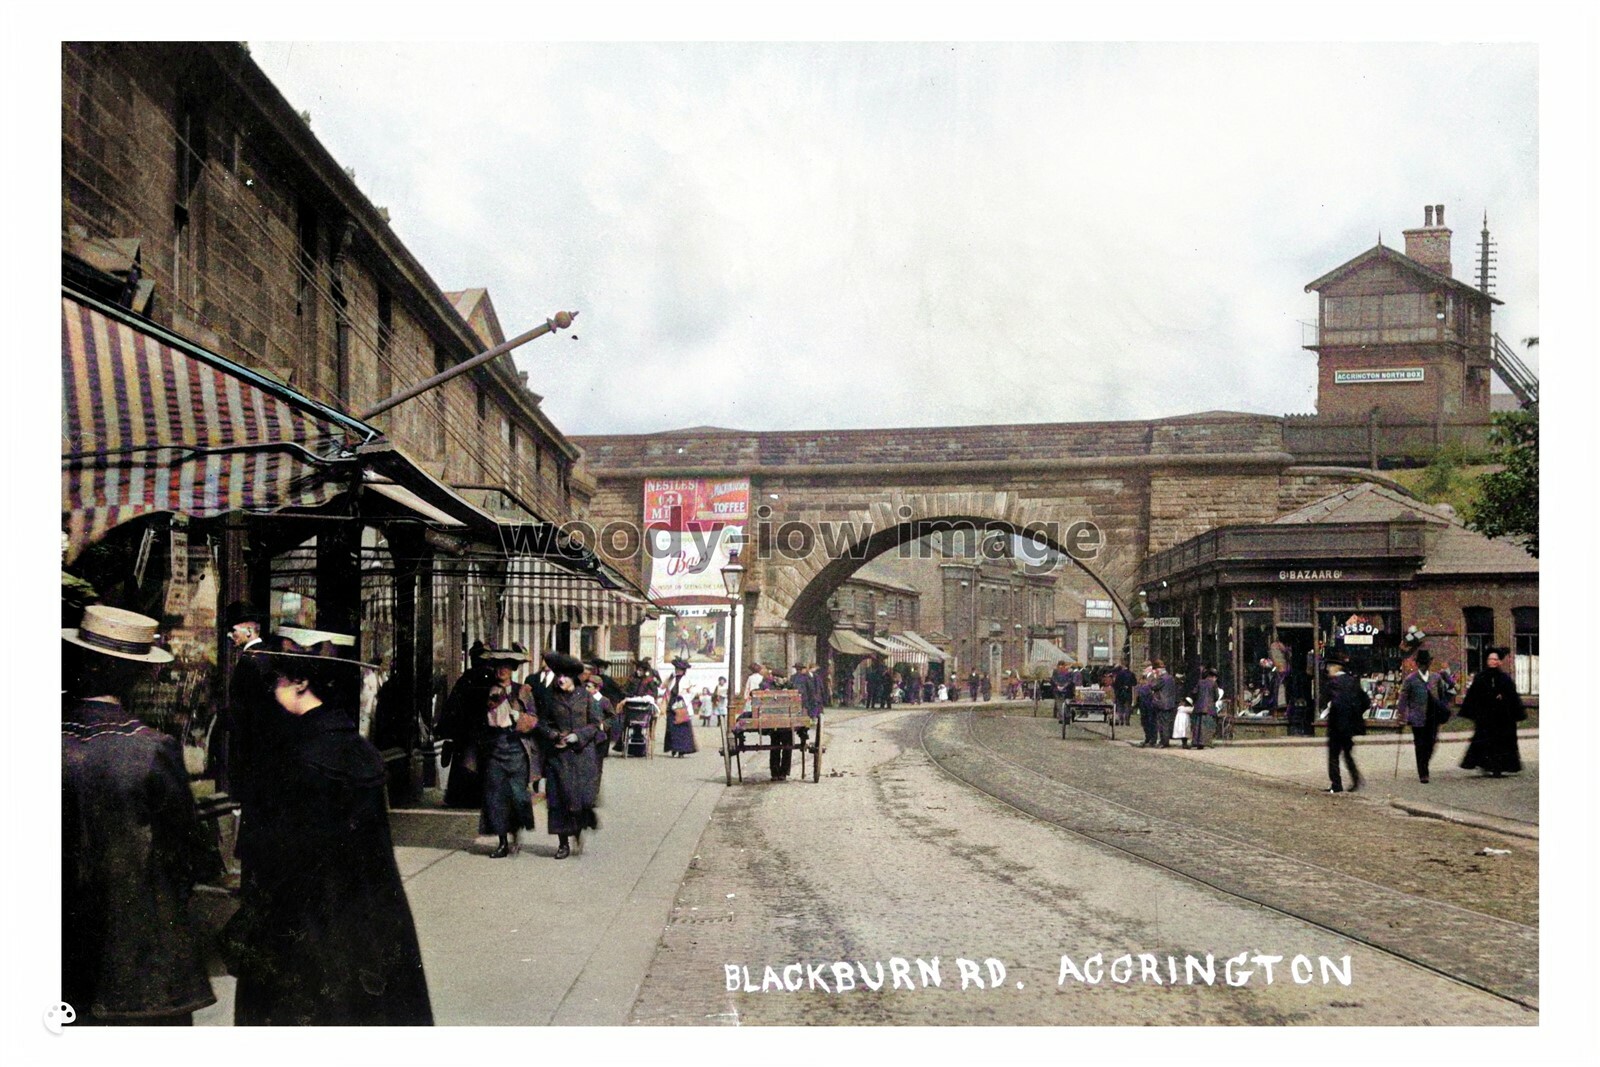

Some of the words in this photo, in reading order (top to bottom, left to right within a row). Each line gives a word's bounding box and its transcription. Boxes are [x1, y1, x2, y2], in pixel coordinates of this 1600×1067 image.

[713, 501, 746, 514] TOFFEE
[1290, 570, 1332, 579] BAZAAR
[1339, 623, 1379, 636] JESSOP
